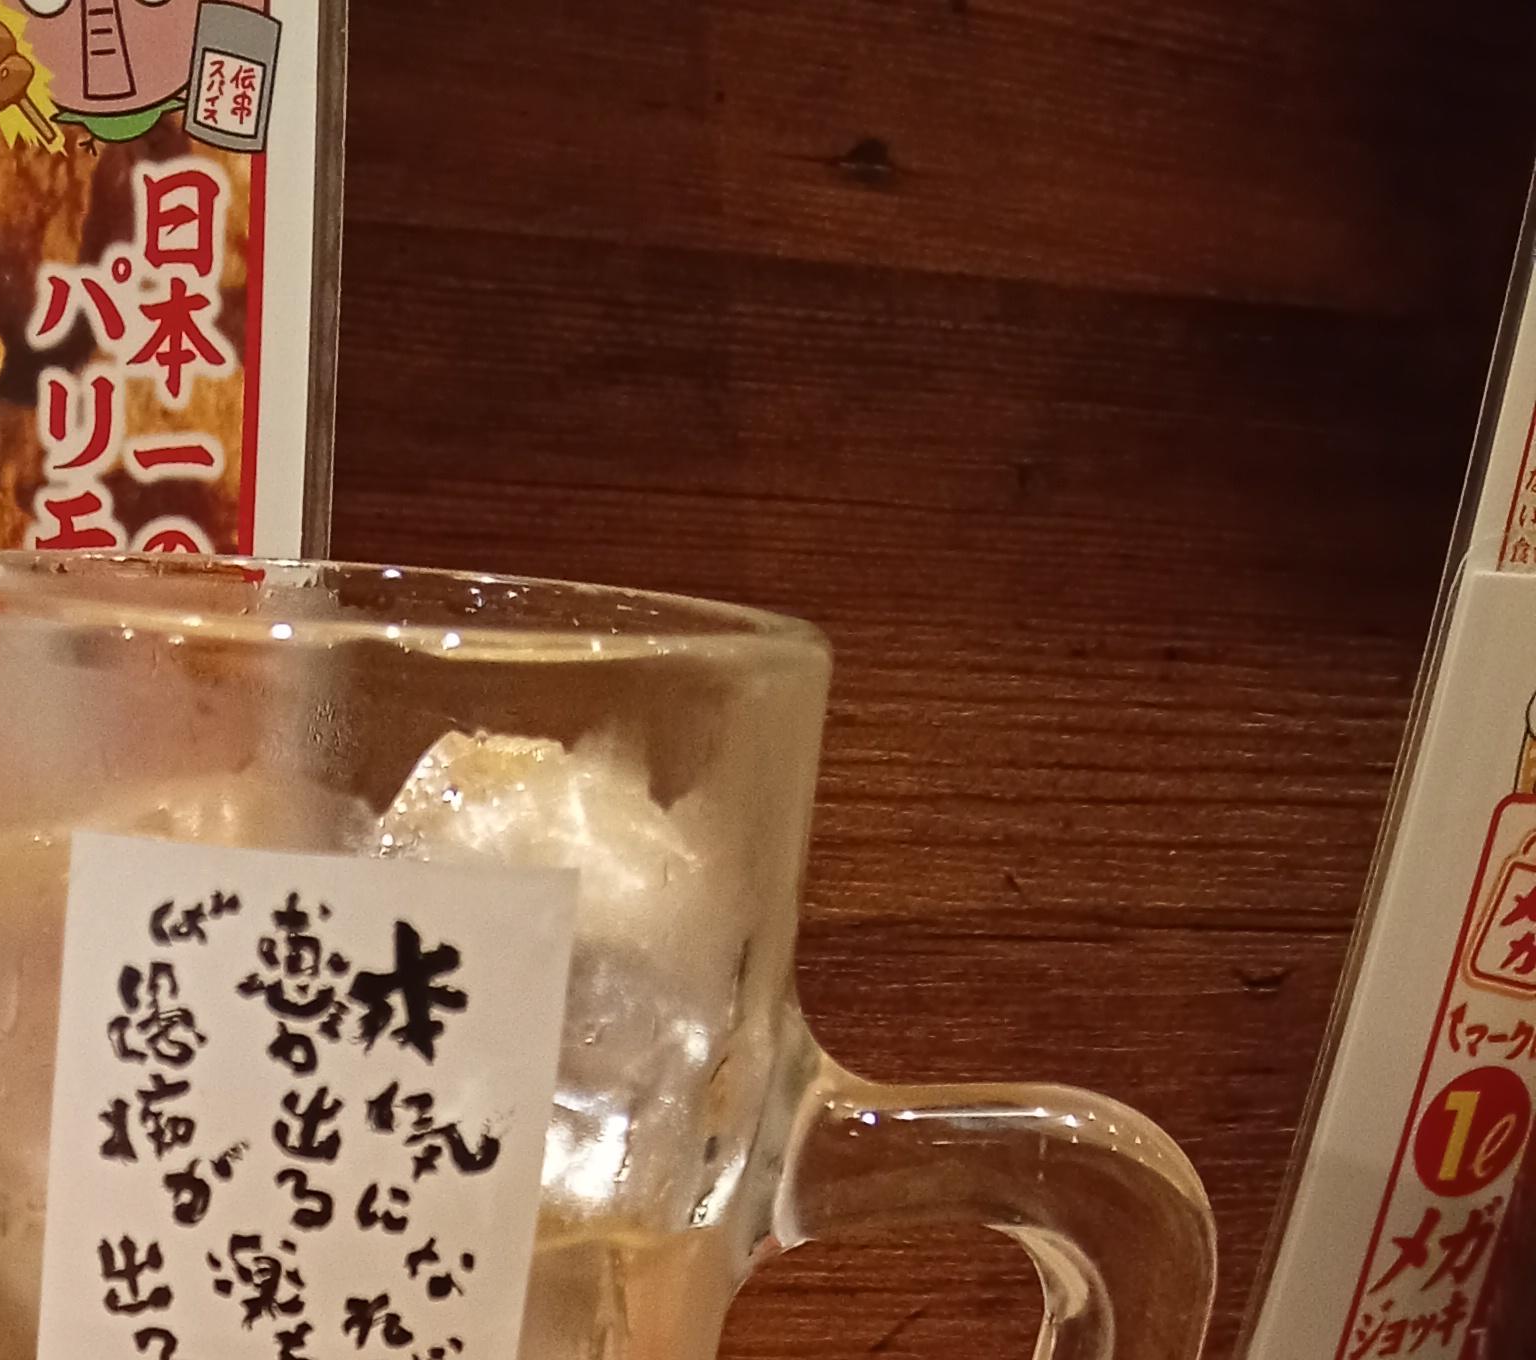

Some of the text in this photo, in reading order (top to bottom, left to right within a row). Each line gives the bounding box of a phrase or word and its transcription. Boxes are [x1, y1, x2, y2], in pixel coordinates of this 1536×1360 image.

[203, 60, 225, 124] スパイス
[230, 65, 256, 125] 伝串
[1464, 1020, 1536, 1061] マーク
[1367, 1195, 1504, 1293] メガ
